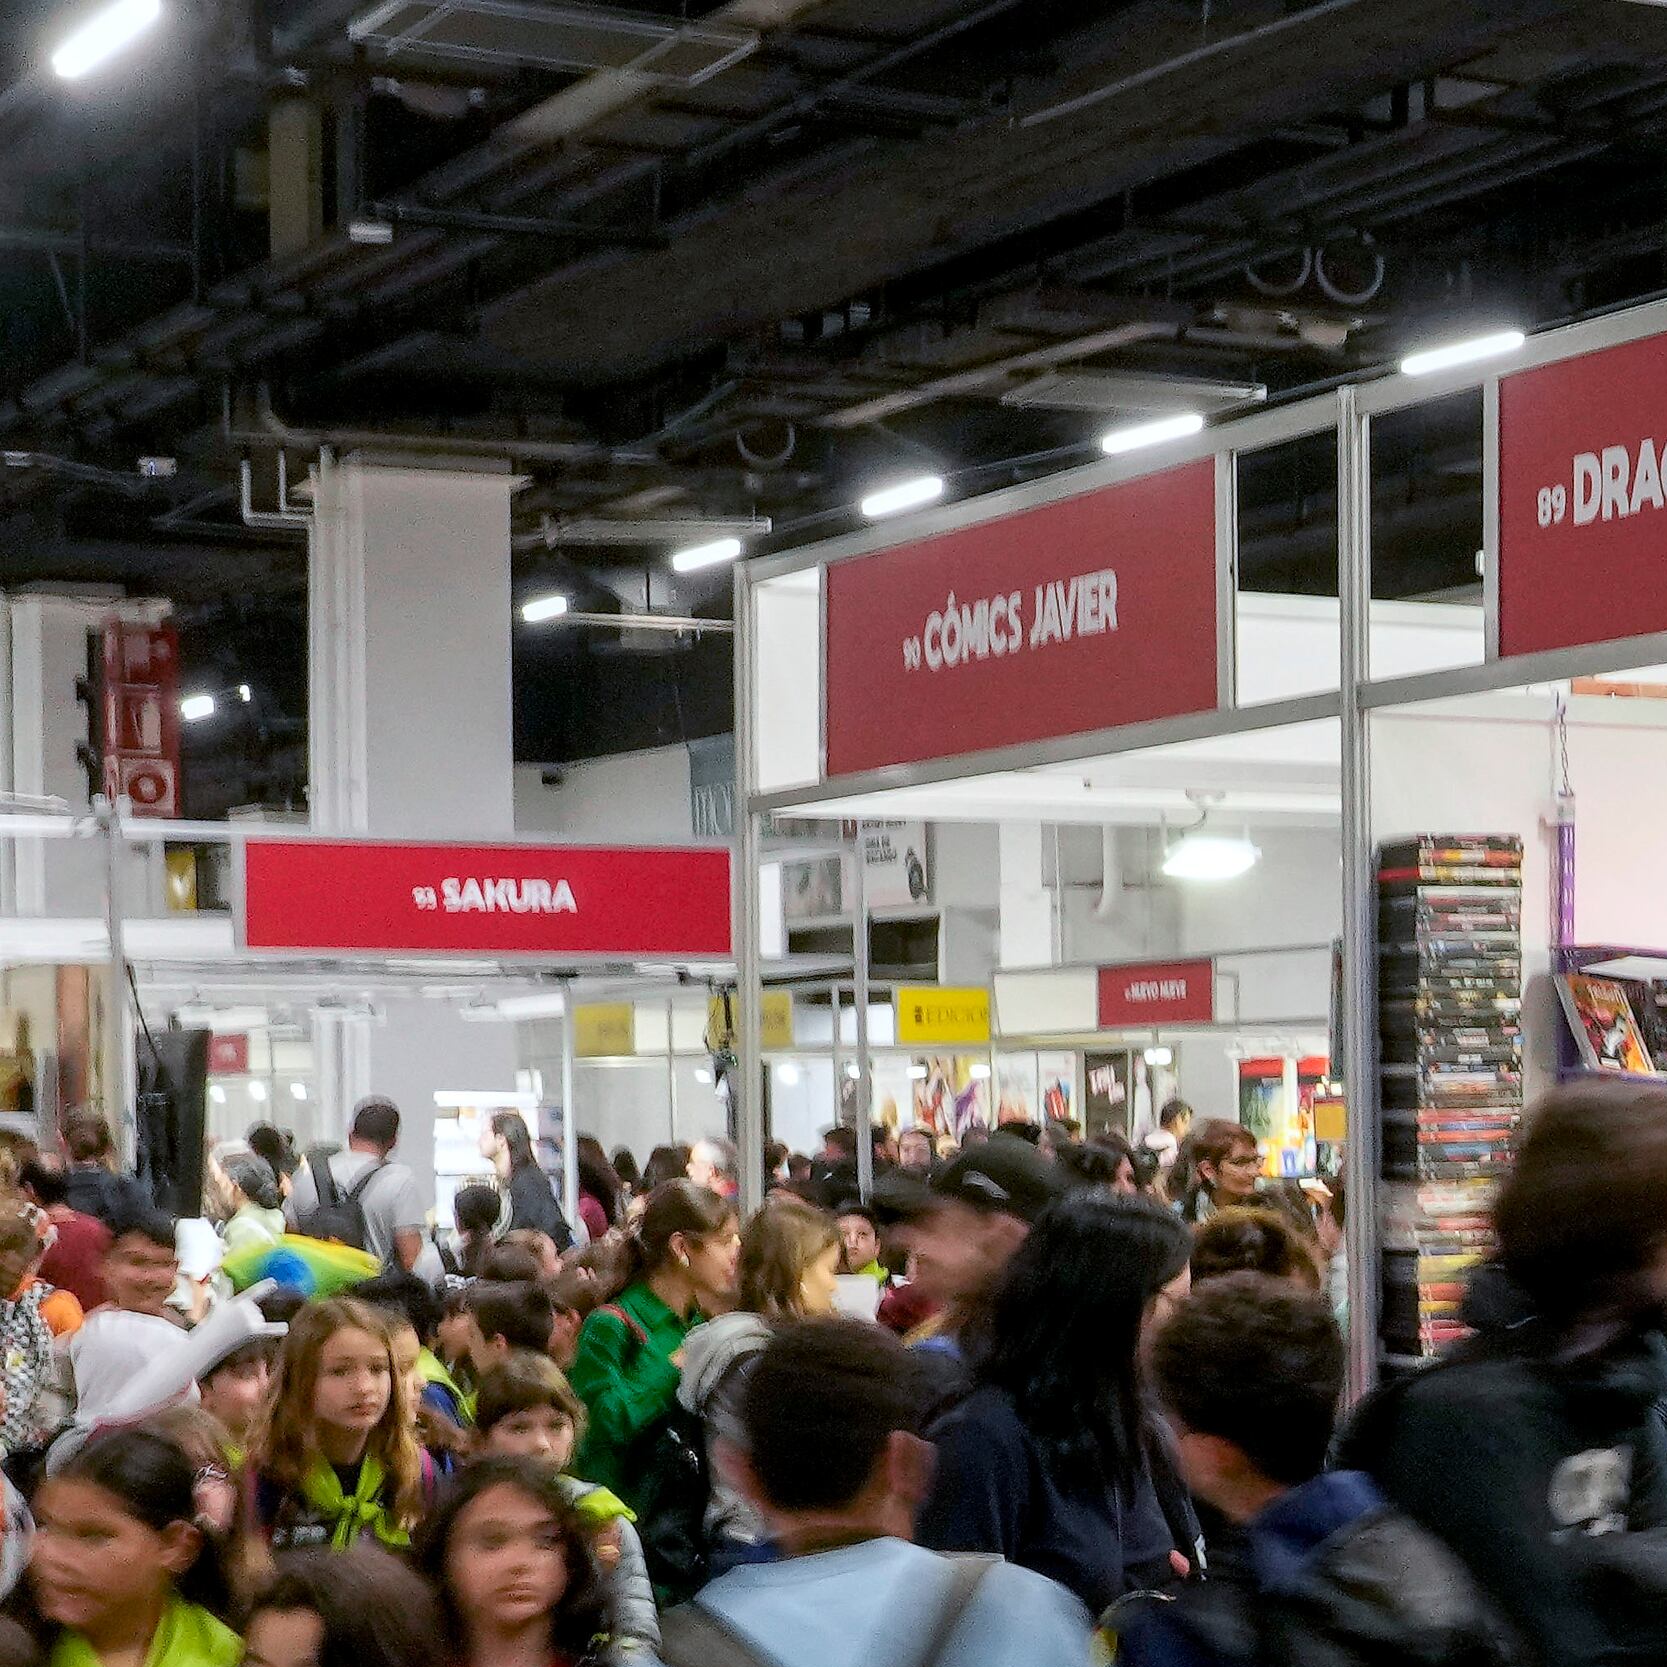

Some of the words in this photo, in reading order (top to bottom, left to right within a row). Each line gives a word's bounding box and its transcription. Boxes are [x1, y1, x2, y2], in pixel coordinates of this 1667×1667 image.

[1536, 482, 1566, 528] 89
[924, 590, 1023, 672] CÓMICS
[1030, 568, 1119, 650] JAVIER
[441, 876, 579, 915] SAKURA
